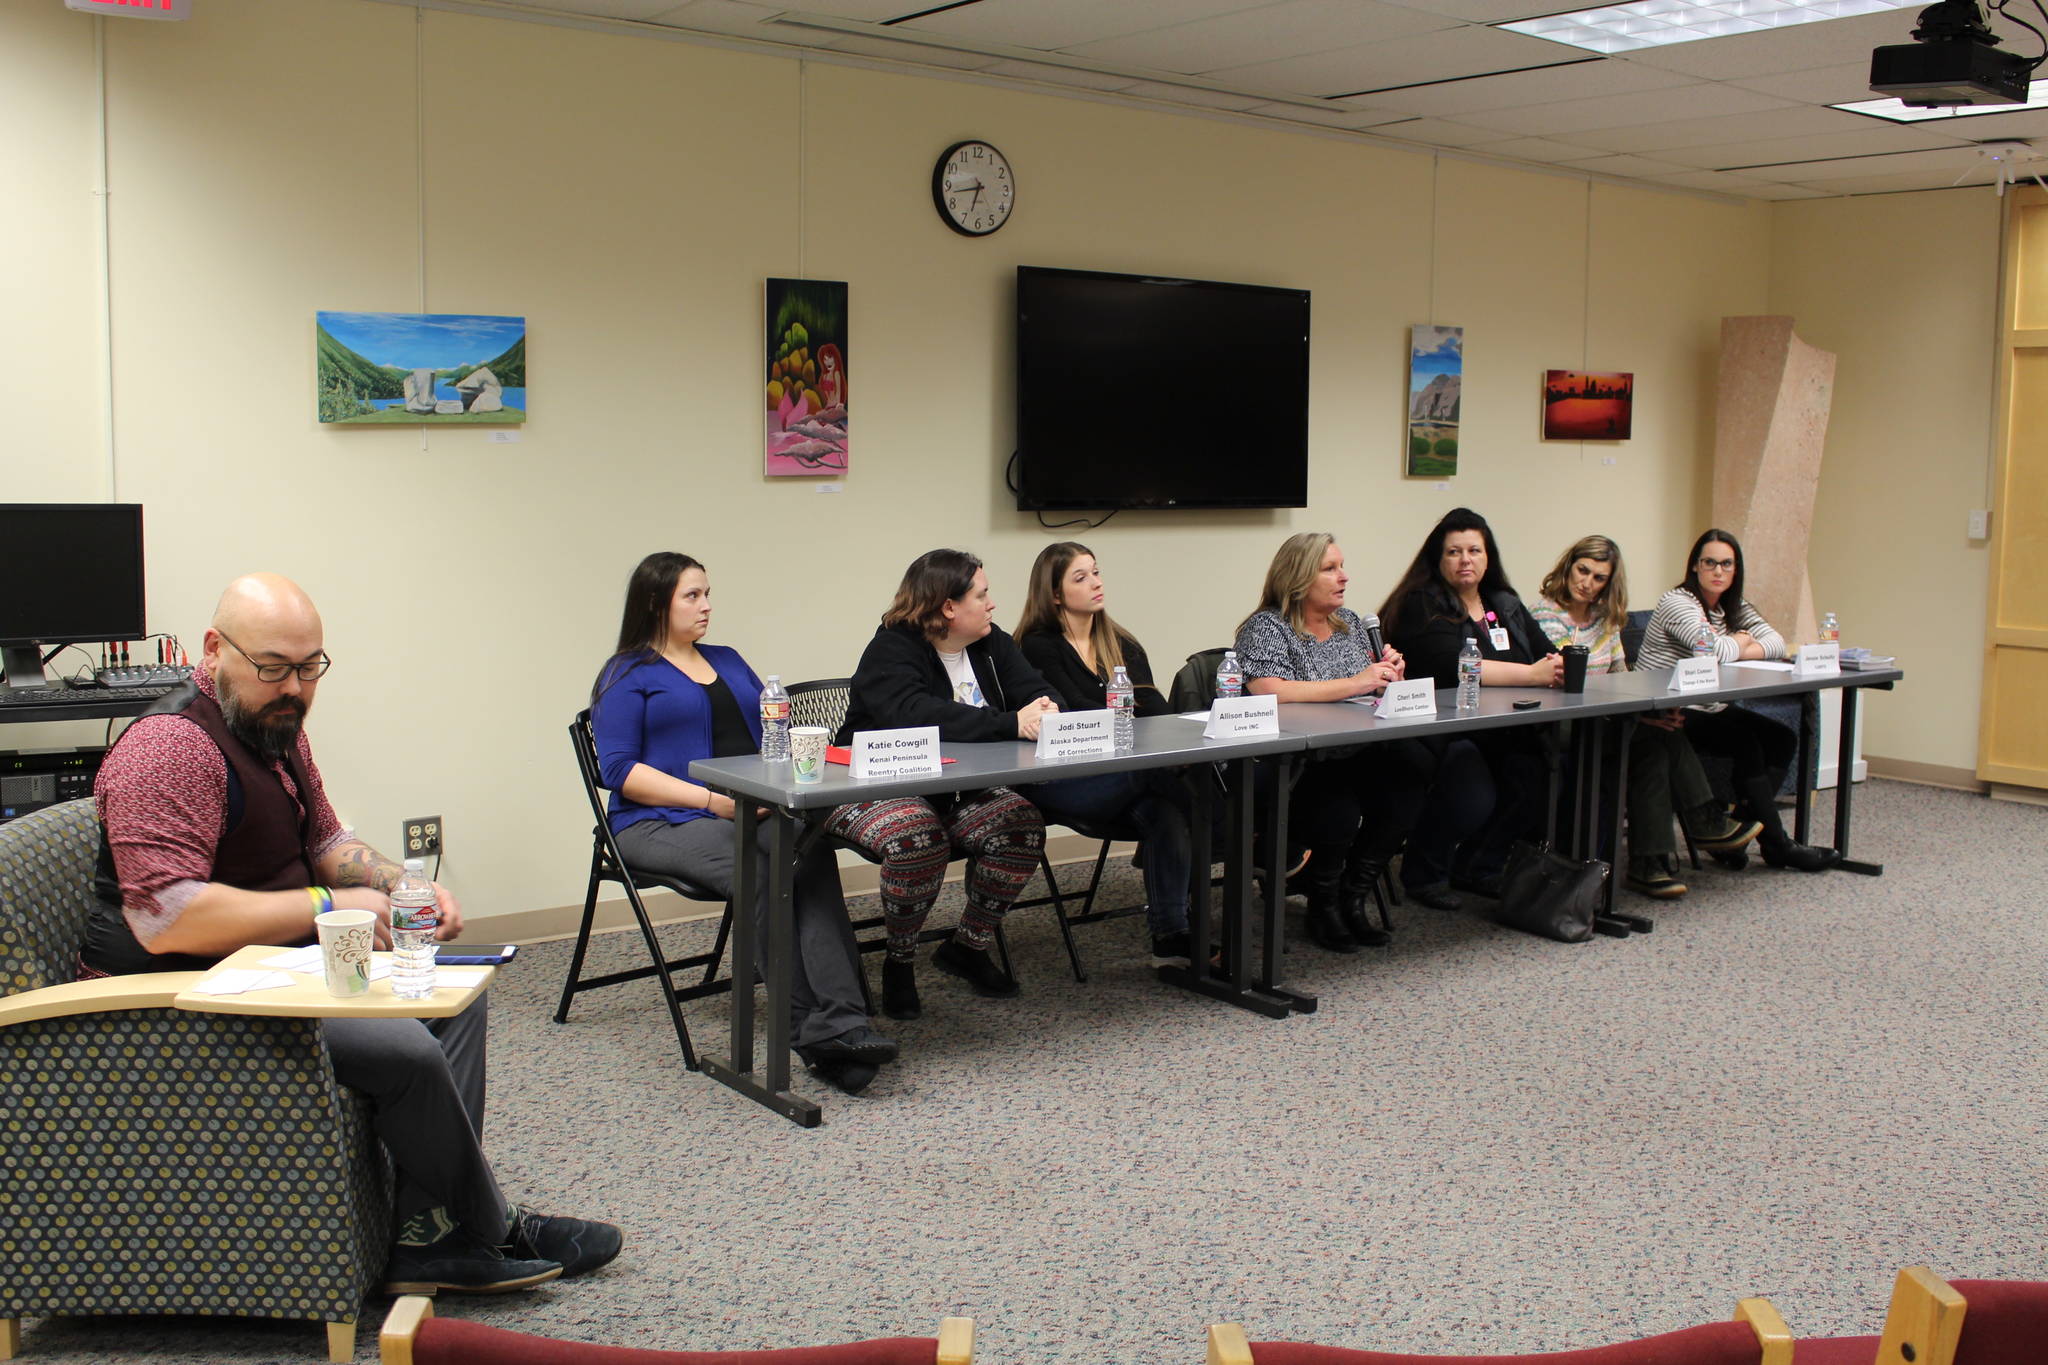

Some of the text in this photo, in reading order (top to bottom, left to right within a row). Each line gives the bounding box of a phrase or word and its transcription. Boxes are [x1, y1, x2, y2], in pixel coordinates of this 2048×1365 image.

[960, 150, 968, 162] 11
[973, 146, 984, 158] 12
[989, 154, 993, 165] 1
[948, 163, 958, 174] 10
[998, 167, 1005, 179] 2
[945, 180, 952, 192] 9
[1003, 185, 1009, 196] 3
[950, 198, 956, 210] 8
[998, 202, 1005, 214] 4
[962, 213, 968, 224] 7
[974, 218, 981, 230] 6
[988, 214, 995, 226] 5
[1244, 710, 1274, 718] Bushnell
[1058, 721, 1100, 732] Jodi Stuart
[868, 738, 928, 750] Katie Cowgill
[1073, 734, 1109, 744] Department
[1067, 747, 1102, 756] Corrections
[893, 753, 928, 762] Peninsula
